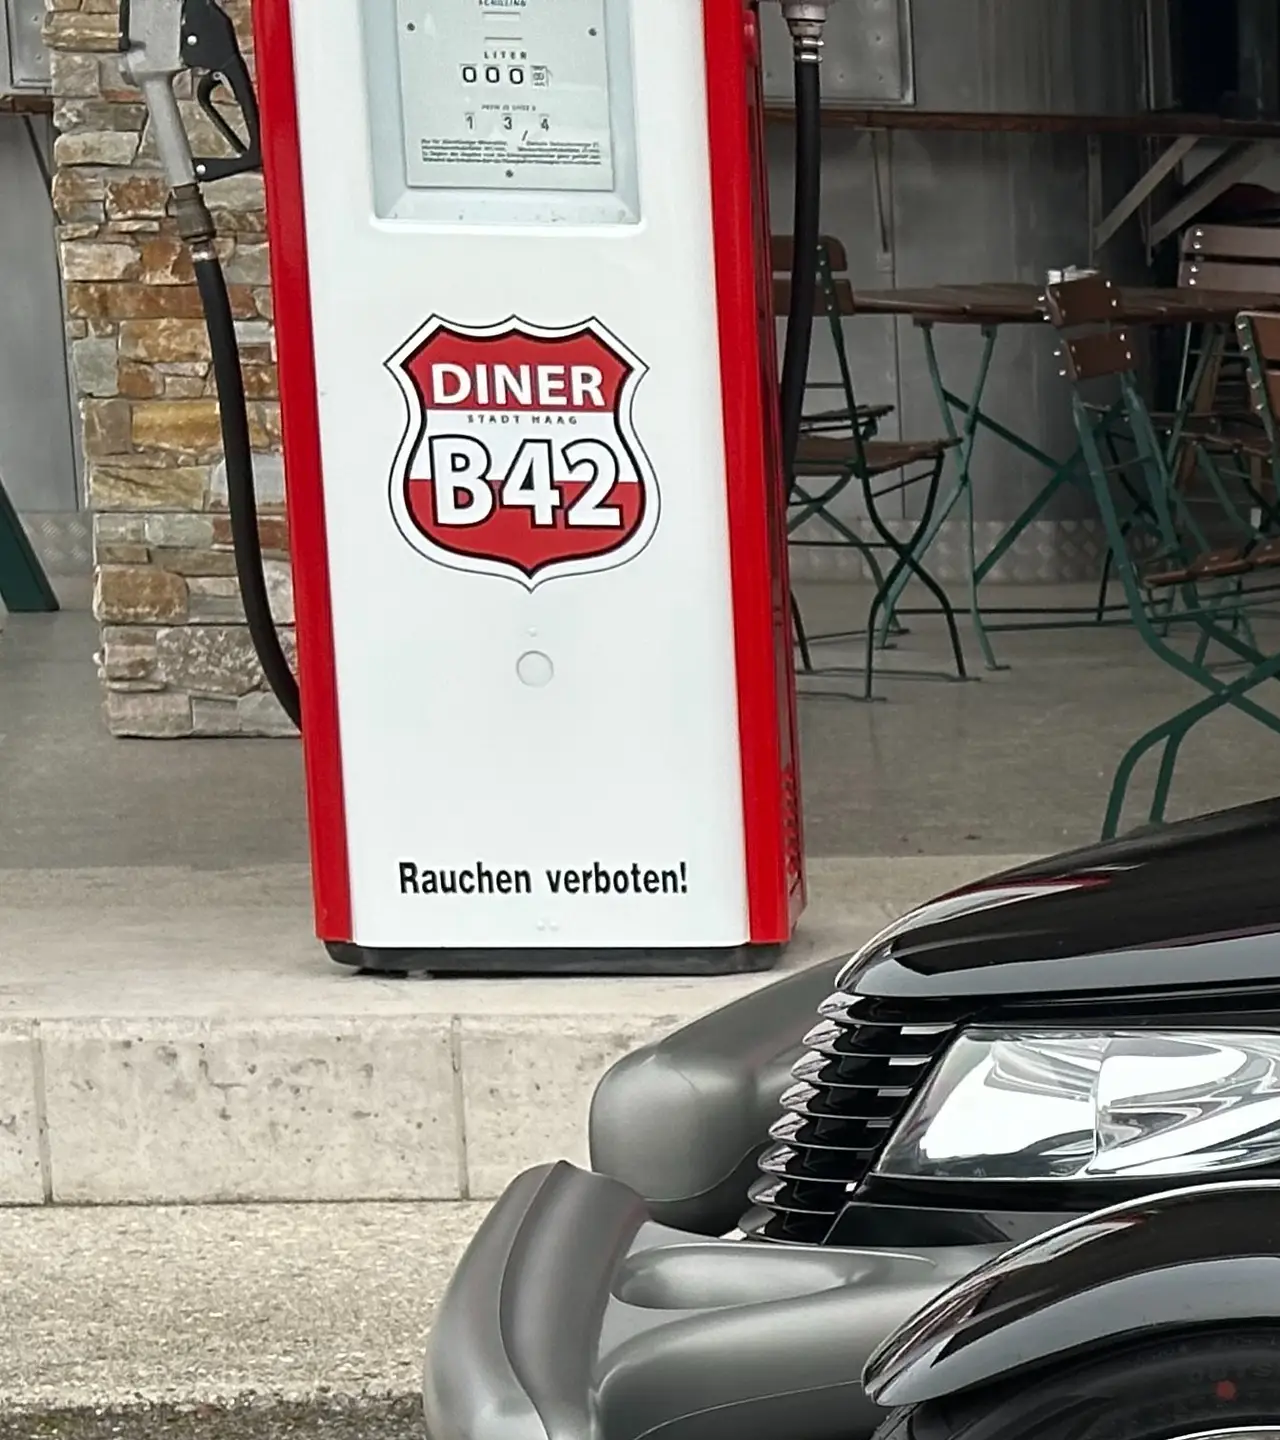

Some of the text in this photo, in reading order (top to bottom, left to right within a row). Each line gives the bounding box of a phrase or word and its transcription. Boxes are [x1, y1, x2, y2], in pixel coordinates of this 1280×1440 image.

[483, 51, 527, 60] LITER
[431, 363, 606, 406] DINER
[467, 414, 578, 425] STADT HAAG
[428, 434, 626, 530] B42
[398, 861, 688, 894] Rauchen verboten!
